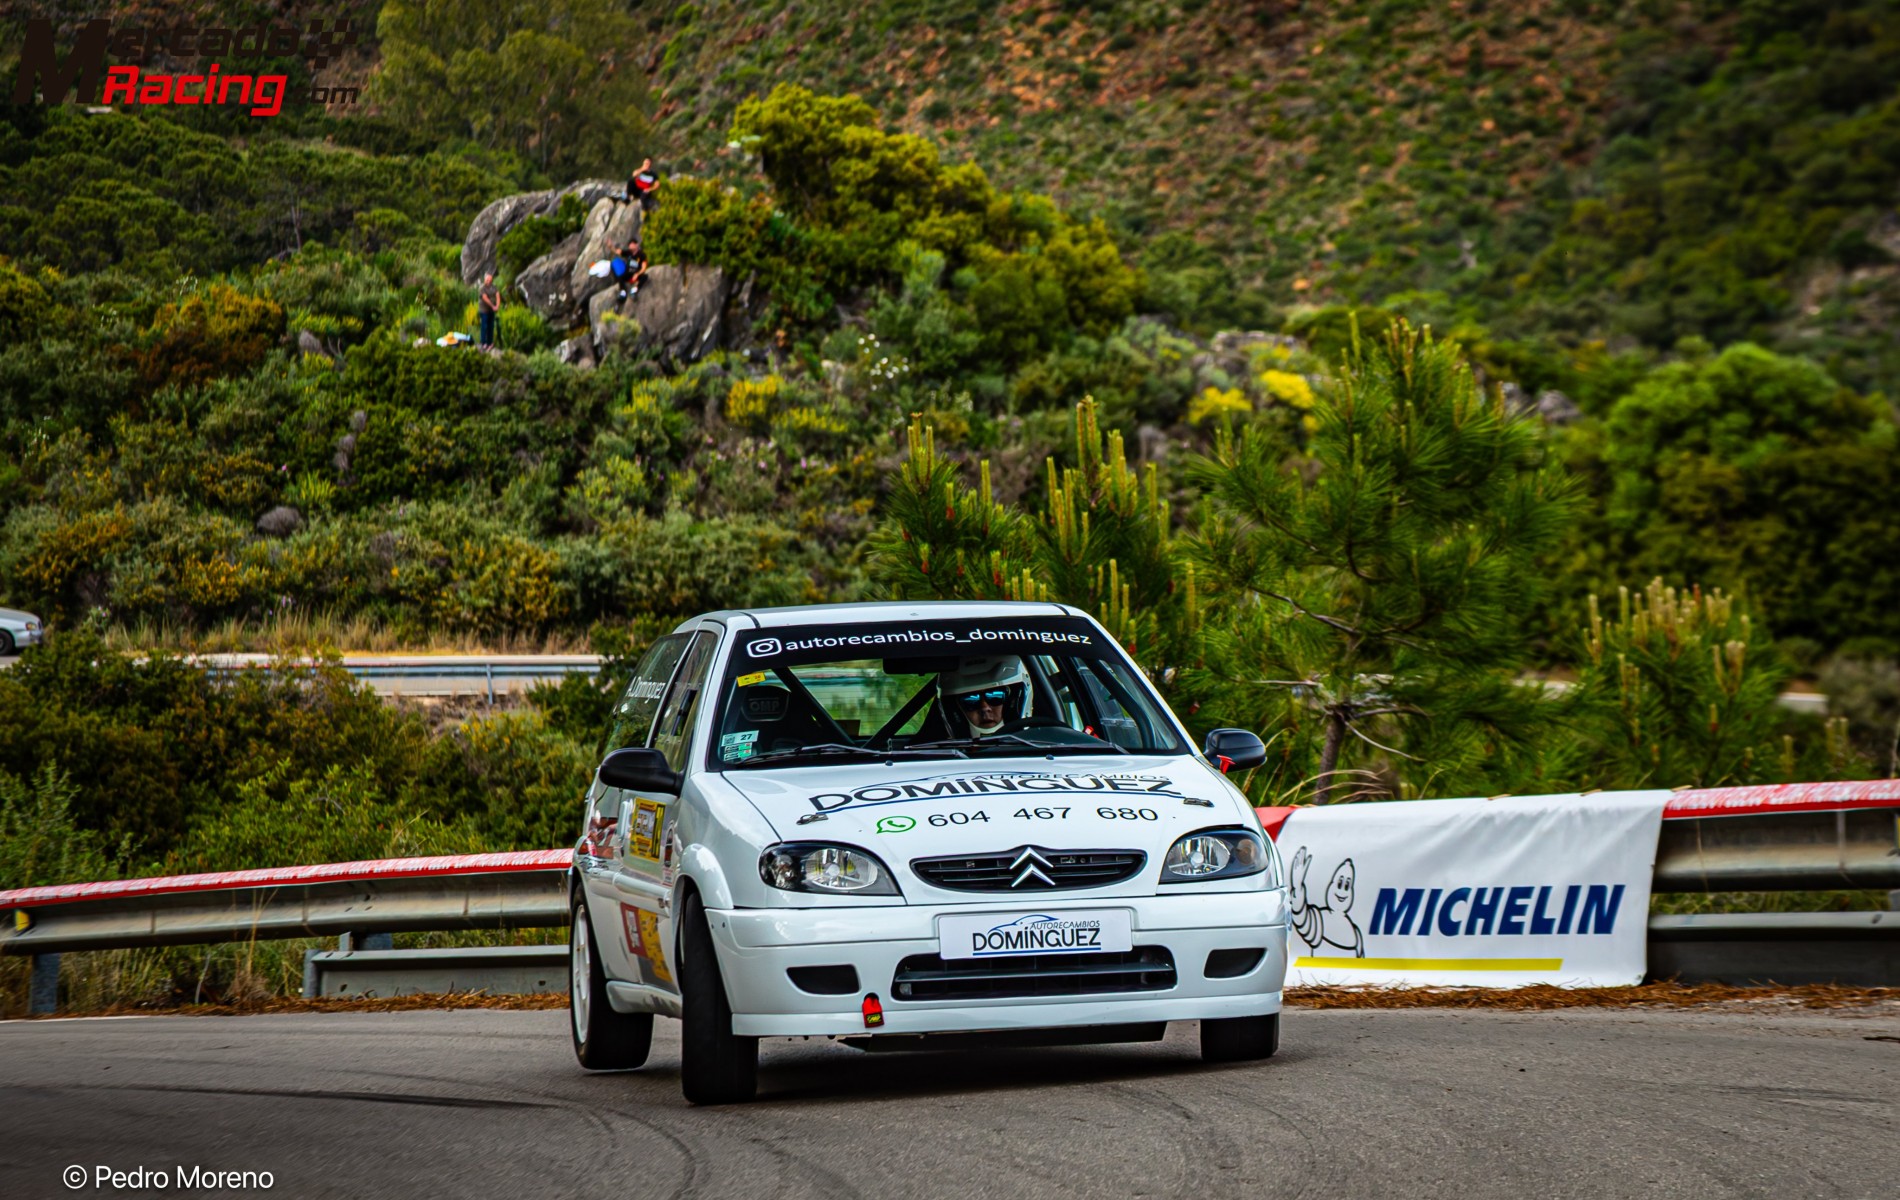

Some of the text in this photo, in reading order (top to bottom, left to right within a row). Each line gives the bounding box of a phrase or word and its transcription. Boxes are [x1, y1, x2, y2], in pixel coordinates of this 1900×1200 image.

[786, 628, 1092, 651] autorecambios_dominguez
[740, 733, 753, 741] 27
[971, 773, 1170, 781] AUTORECAMBIOS
[927, 807, 1159, 827] 604 467 680
[1368, 884, 1626, 937] MICHELIN
[1029, 920, 1101, 931] AUTORECAMBIOS
